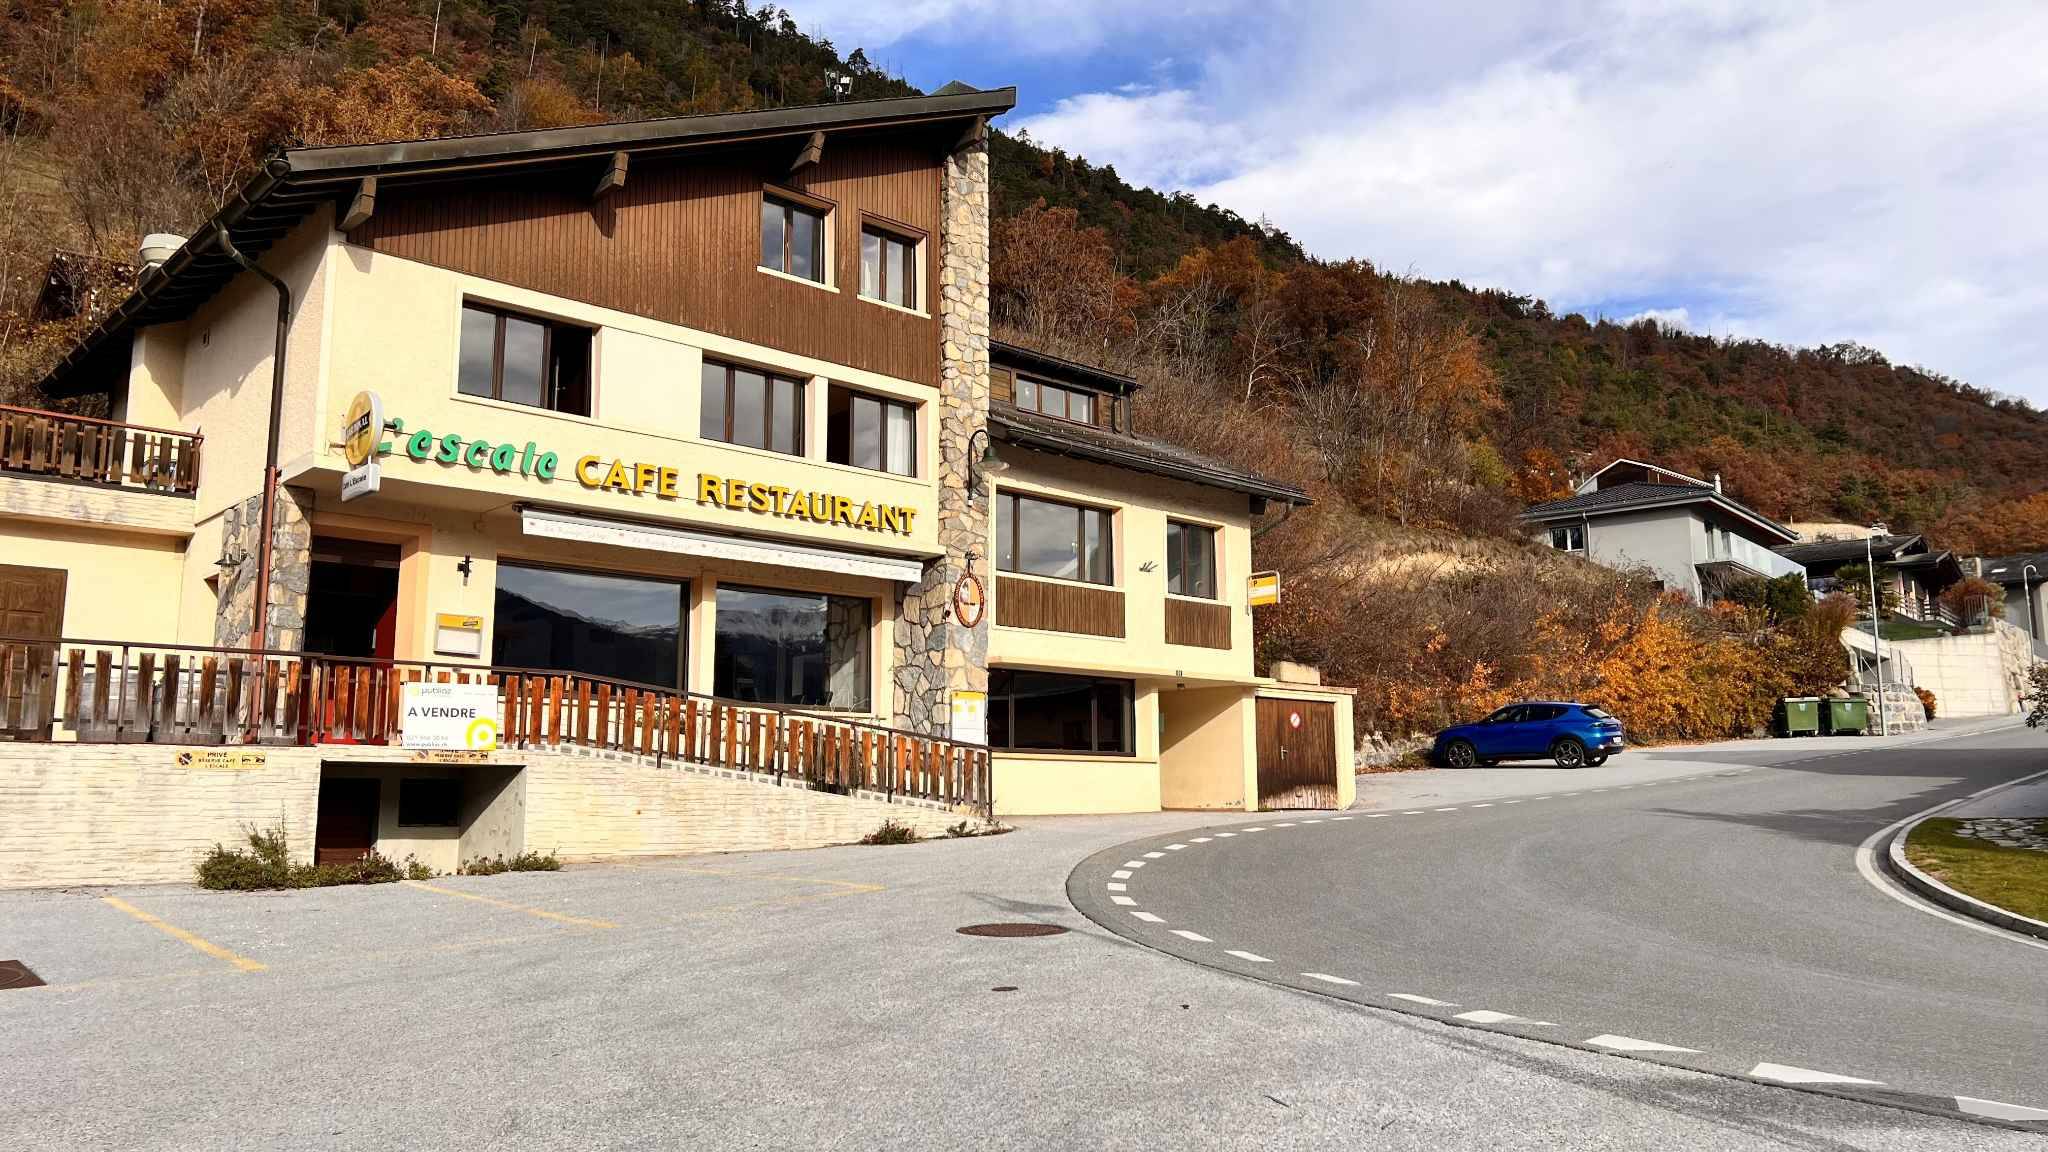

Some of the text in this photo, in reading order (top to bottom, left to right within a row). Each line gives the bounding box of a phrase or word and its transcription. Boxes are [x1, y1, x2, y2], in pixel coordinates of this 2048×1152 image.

[576, 455, 680, 498] CAFE
[698, 473, 918, 534] RESTAURANT
[407, 706, 477, 718] A VENDRE
